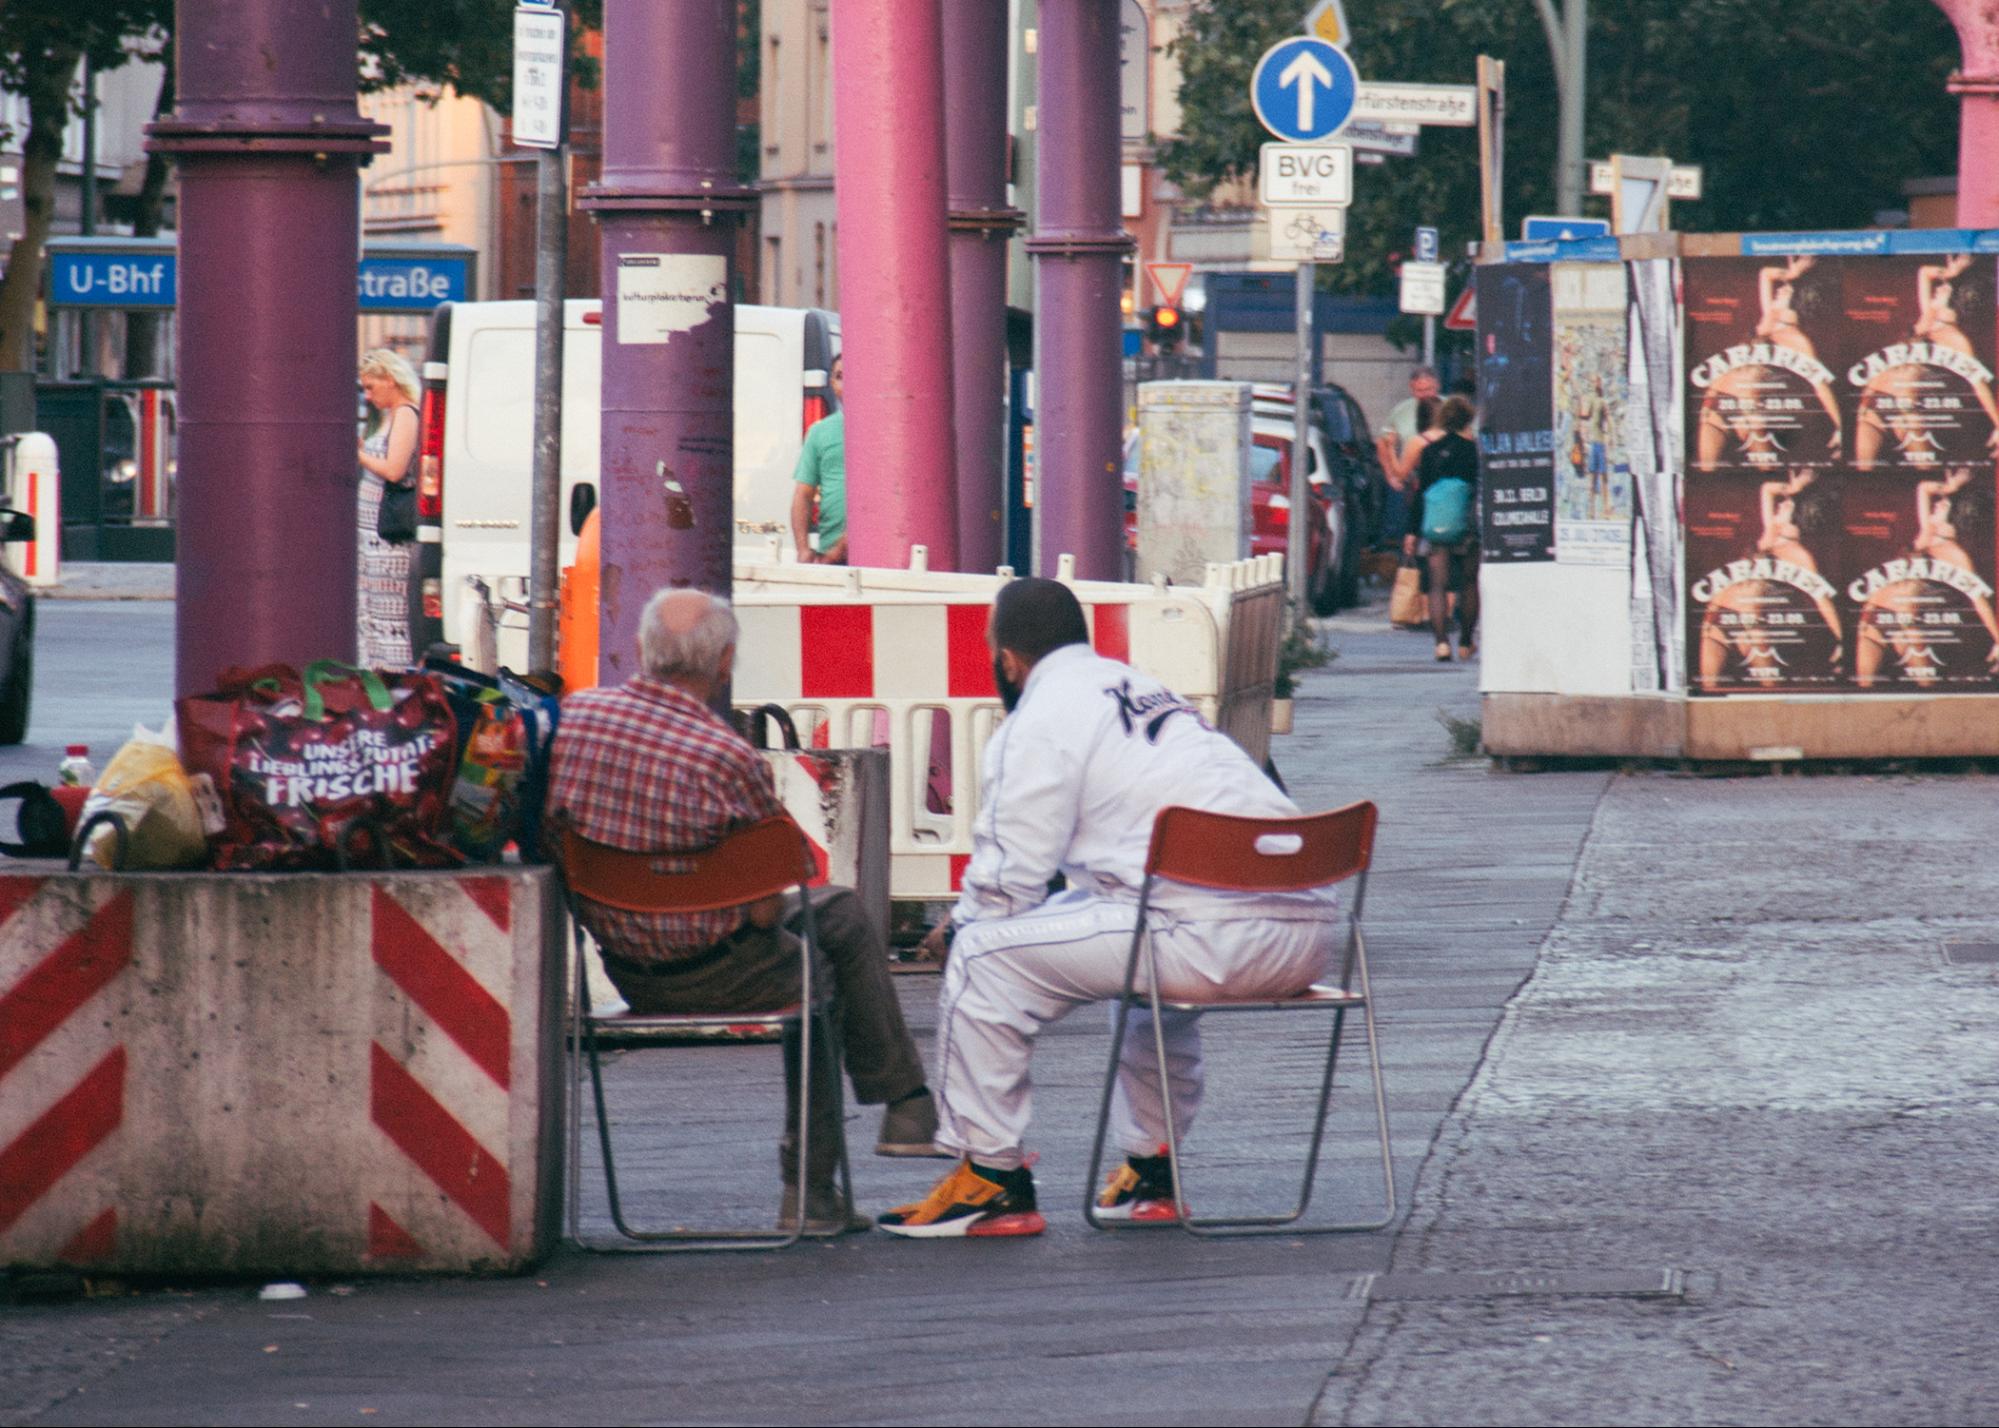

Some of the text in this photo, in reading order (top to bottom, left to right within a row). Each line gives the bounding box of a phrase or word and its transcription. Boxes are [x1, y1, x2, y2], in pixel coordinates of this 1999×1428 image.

[1279, 155, 1335, 178] BVG
[1291, 181, 1321, 196] frei
[69, 263, 164, 295] U-Bhf
[1691, 343, 1836, 388] CABARET
[1847, 341, 1995, 387] CABARET
[1691, 558, 1838, 603] CABARET
[1848, 557, 1995, 602] CABARET
[266, 759, 420, 807] FRISCHE
